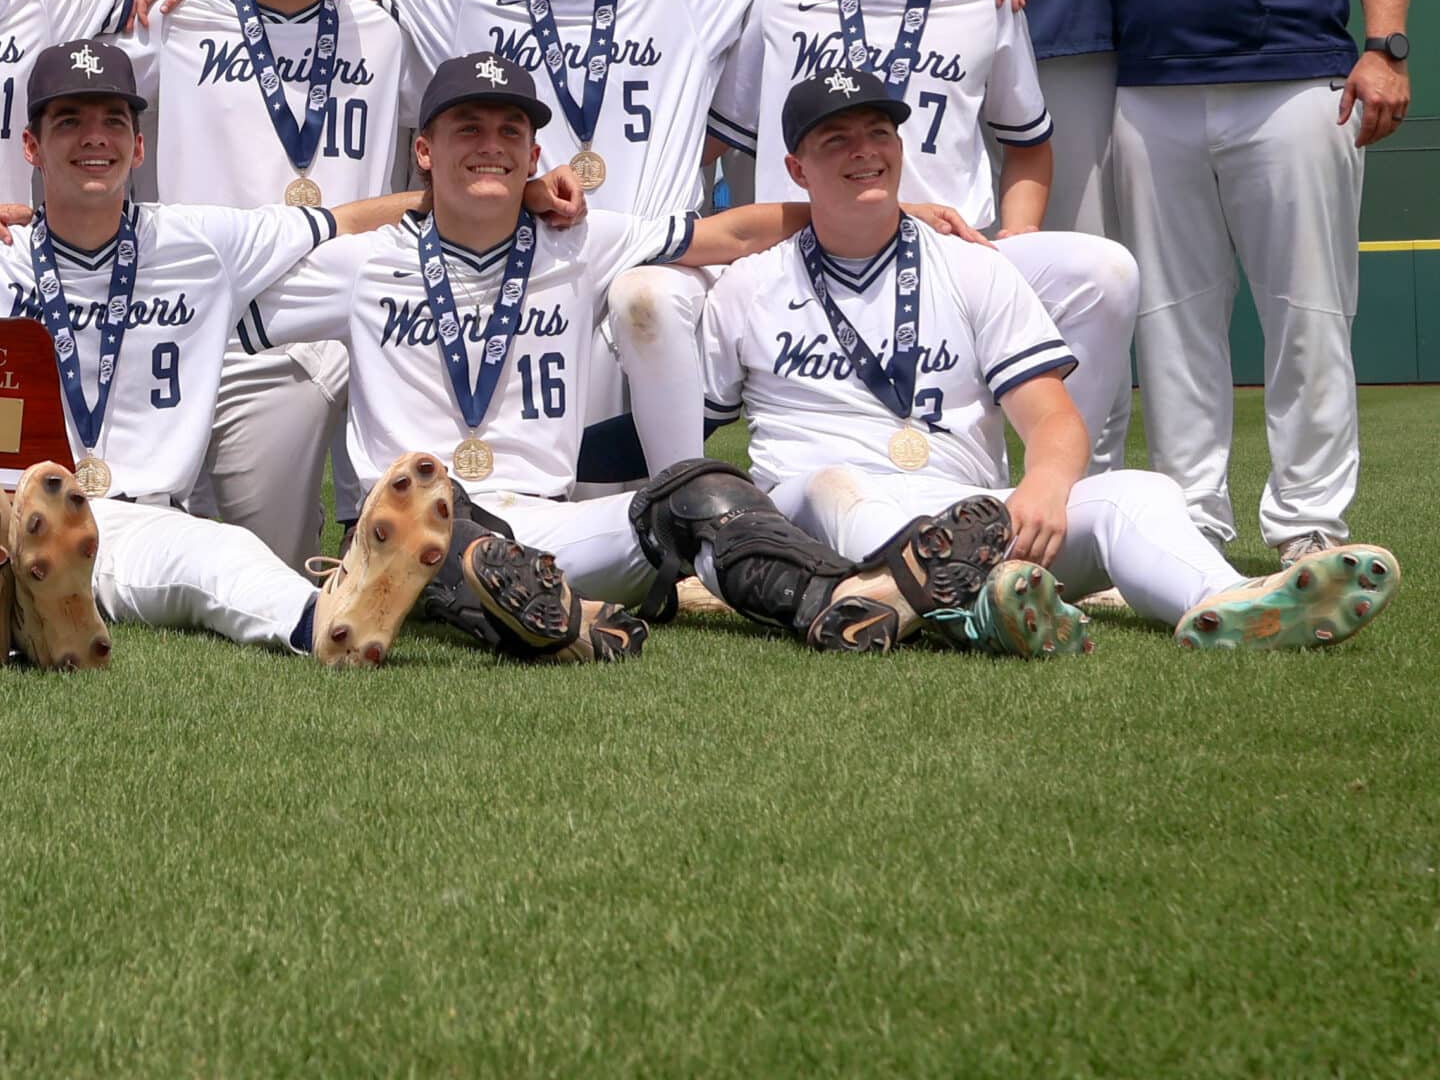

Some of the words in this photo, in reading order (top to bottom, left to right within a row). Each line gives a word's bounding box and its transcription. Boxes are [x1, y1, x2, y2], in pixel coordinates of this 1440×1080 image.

[197, 38, 375, 87] Warirs
[488, 26, 662, 72] Warrs
[790, 31, 967, 83] Warrs
[323, 97, 368, 160] 10
[623, 80, 652, 142] 5
[918, 91, 948, 155] 7
[8, 282, 196, 331] Wrrors
[379, 296, 569, 348] Warrs
[150, 341, 182, 409] 9
[773, 331, 959, 381] Warirs
[517, 351, 566, 420] 16
